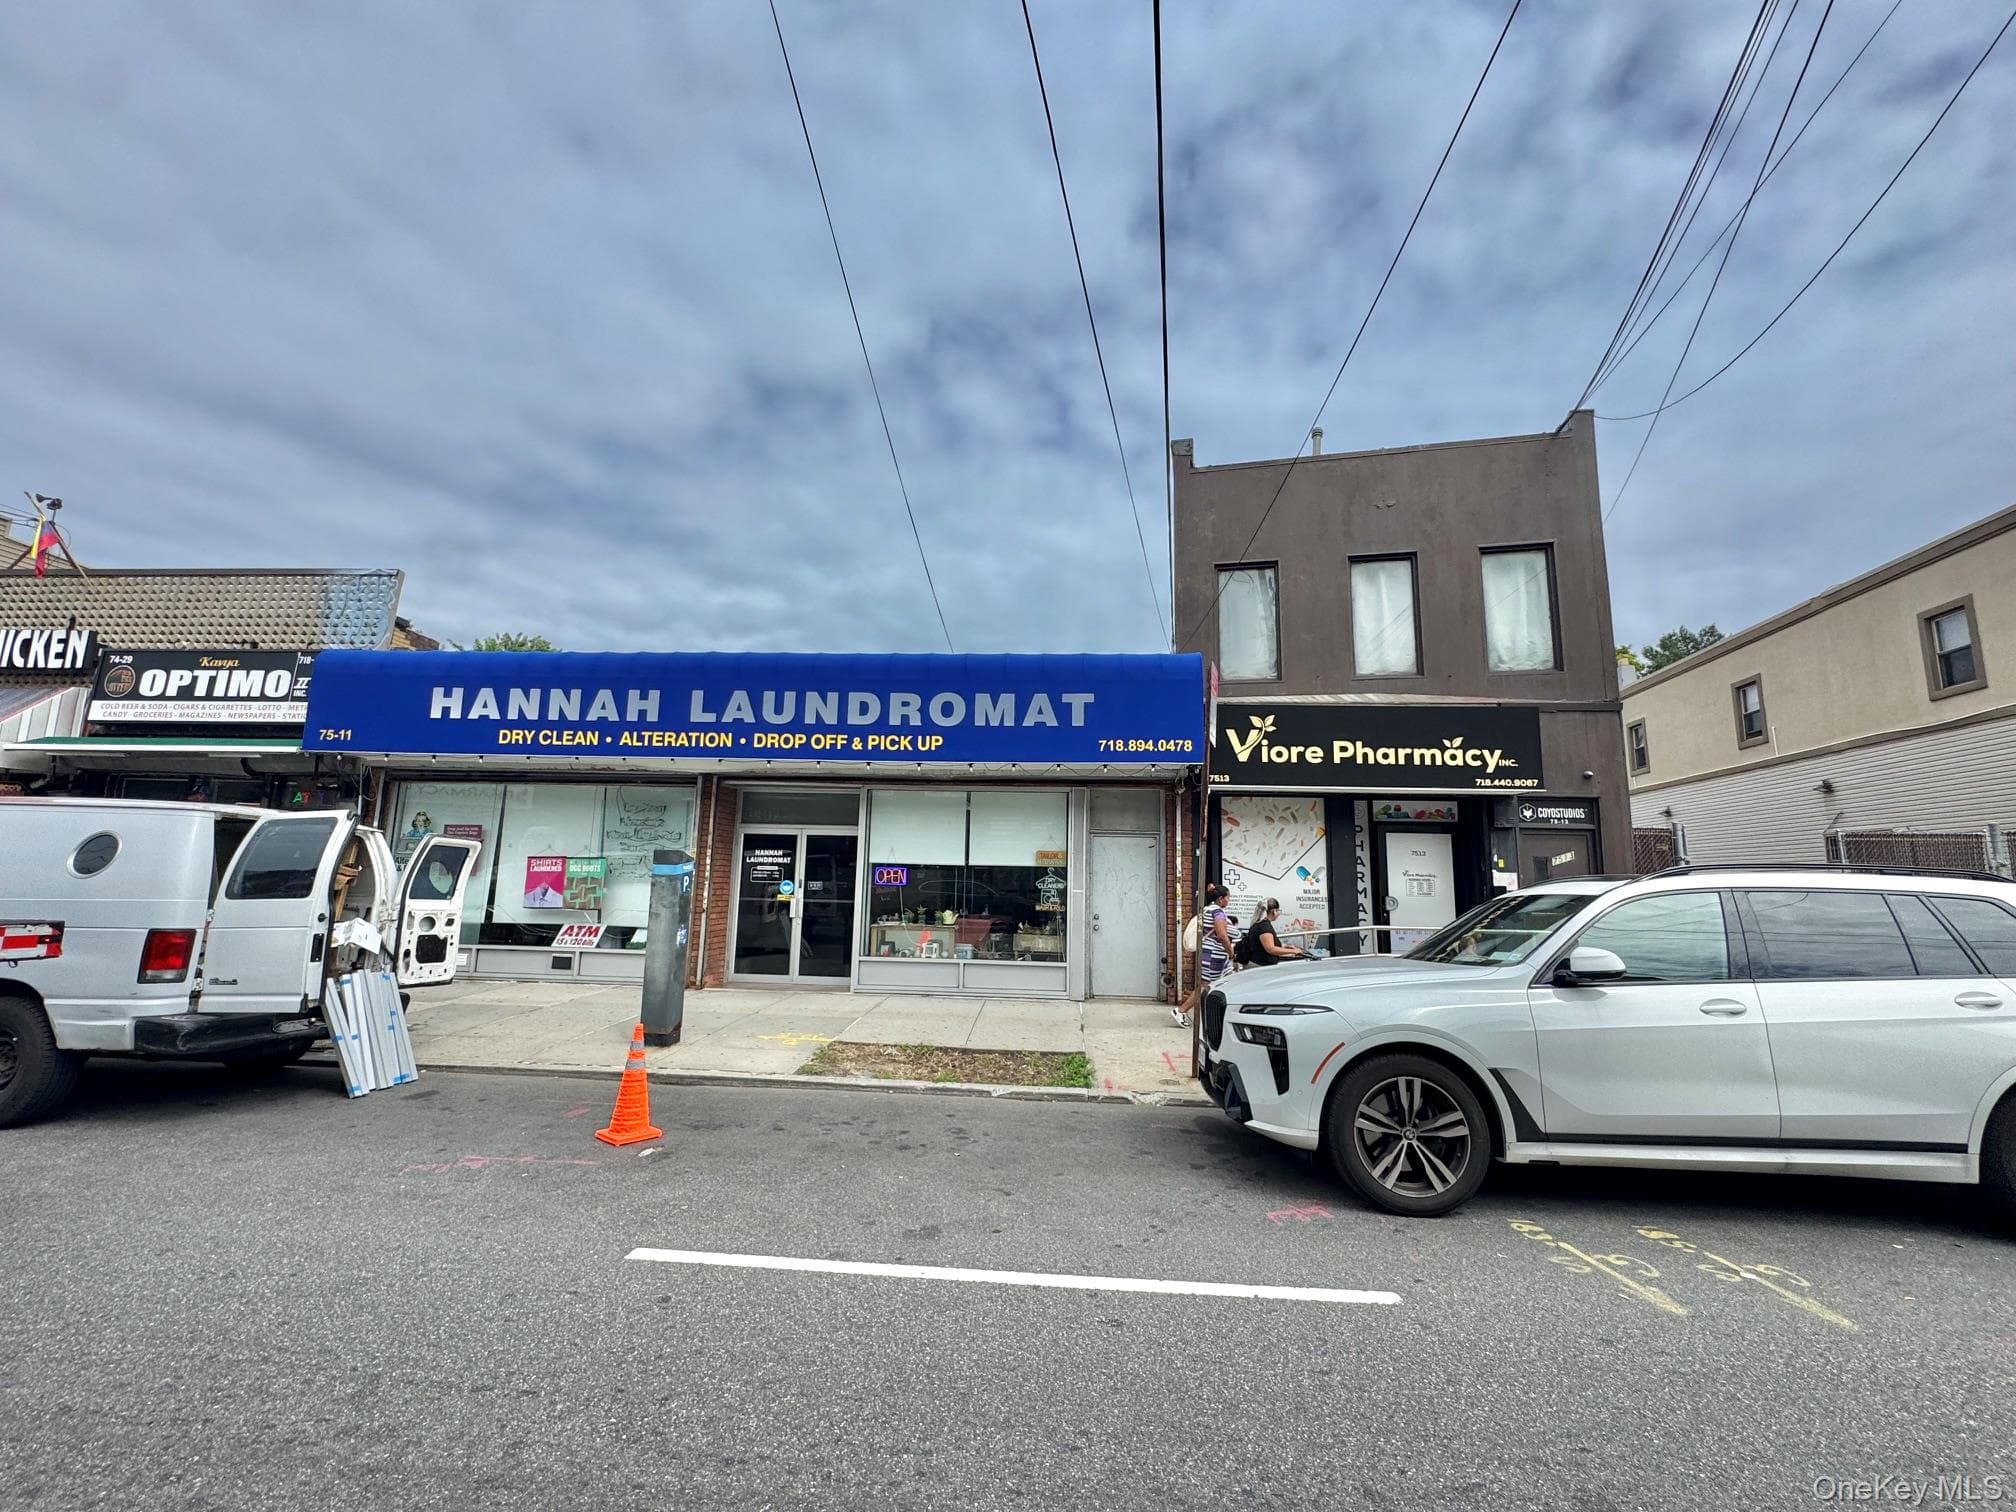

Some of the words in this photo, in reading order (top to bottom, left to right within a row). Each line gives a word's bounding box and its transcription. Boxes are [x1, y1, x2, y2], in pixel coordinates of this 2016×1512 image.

[110, 655, 133, 664] 74-29
[199, 656, 240, 669] Kavya
[139, 669, 292, 698] OPTIMO
[430, 687, 660, 722] HANNAH
[690, 689, 1095, 727] LAUNDROMAT
[319, 729, 351, 741] 75-11
[498, 729, 535, 745] DRY
[540, 730, 598, 746] CLEAN
[619, 731, 732, 748] ALTERATION
[753, 733, 806, 749] DROP
[811, 734, 848, 750] OFF
[852, 737, 863, 750] &
[868, 735, 913, 751] PICK
[917, 735, 943, 751] UP
[1098, 739, 1193, 752] 718.894.0478
[1226, 726, 1324, 763] Viore
[1333, 741, 1502, 773] Pharmacy
[1498, 759, 1519, 767] INC.
[1209, 775, 1230, 783] 7513
[1537, 807, 1585, 818] COYOSTUDIOS
[746, 856, 791, 864] LAUNDROMAT
[877, 868, 906, 884] OPEN
[560, 925, 601, 938] ATM
